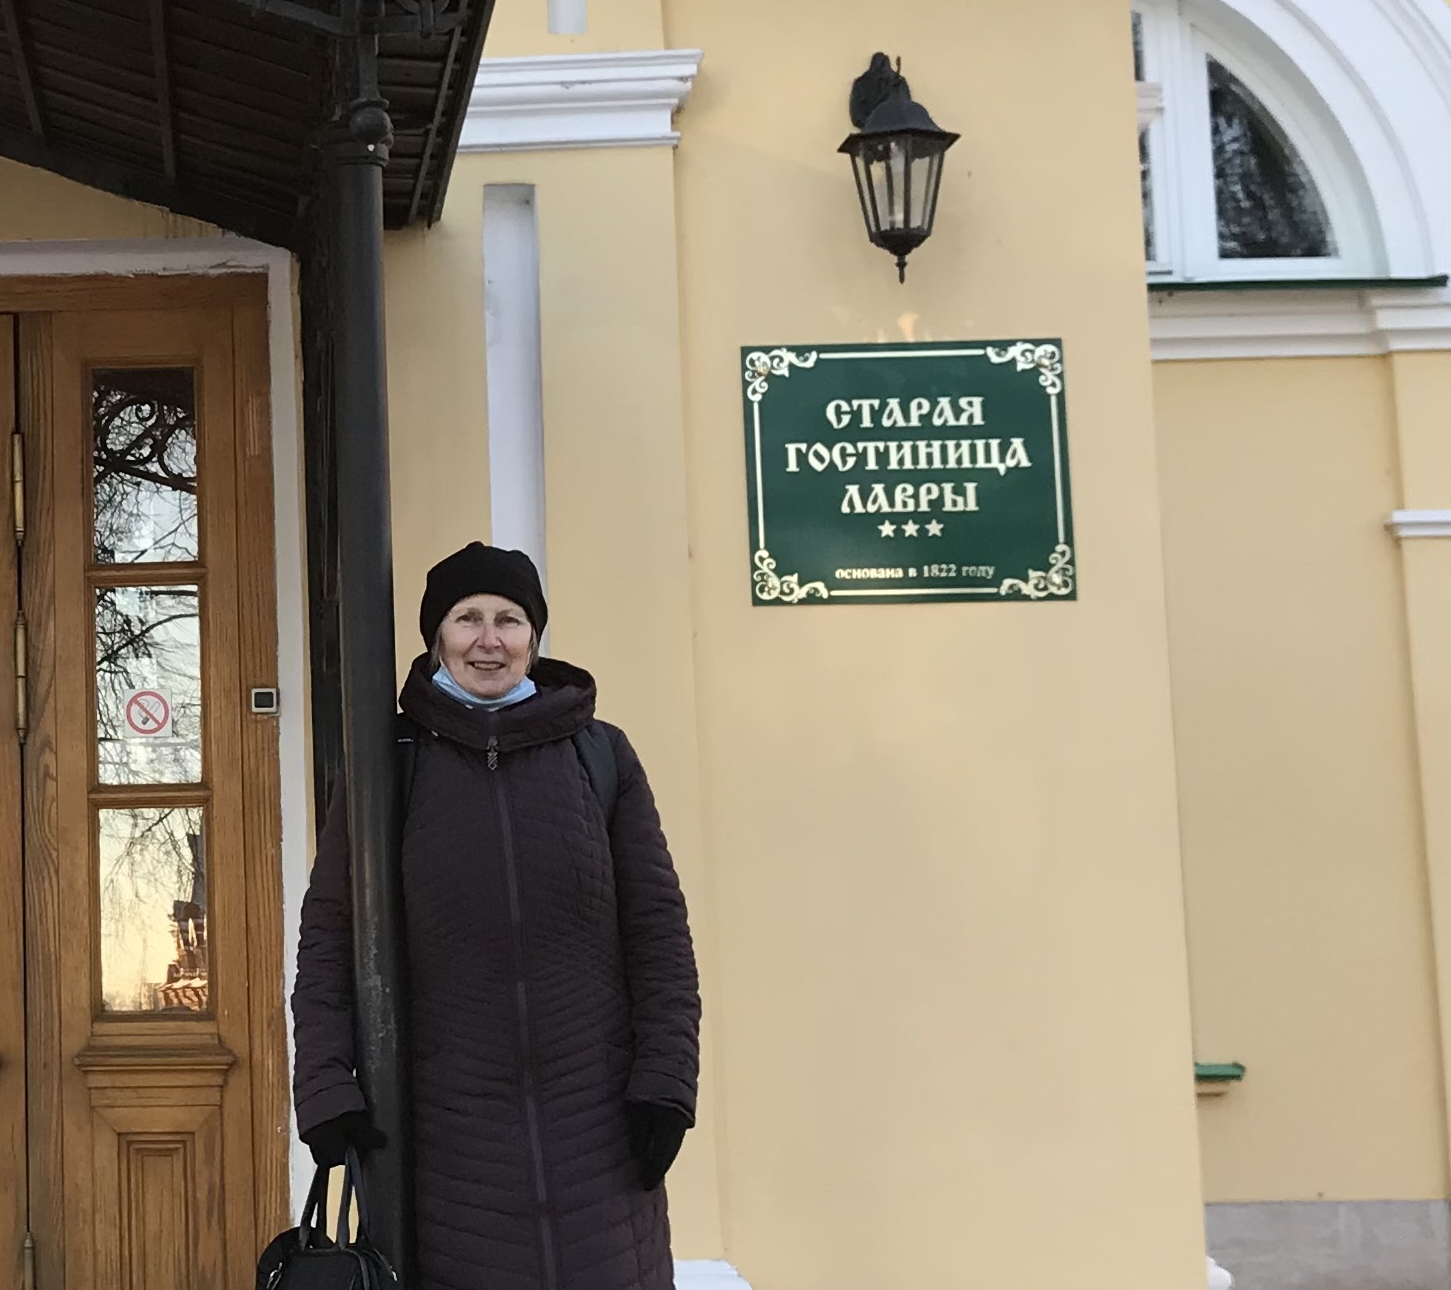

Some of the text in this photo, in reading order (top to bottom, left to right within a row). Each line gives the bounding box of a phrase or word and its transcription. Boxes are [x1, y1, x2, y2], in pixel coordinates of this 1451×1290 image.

[825, 396, 985, 429] СТАРАЯ
[784, 437, 1032, 476] ГОСТИНИЦА
[840, 482, 979, 514] ЛАВРЫ
[835, 564, 995, 580] основана в 1822 году
